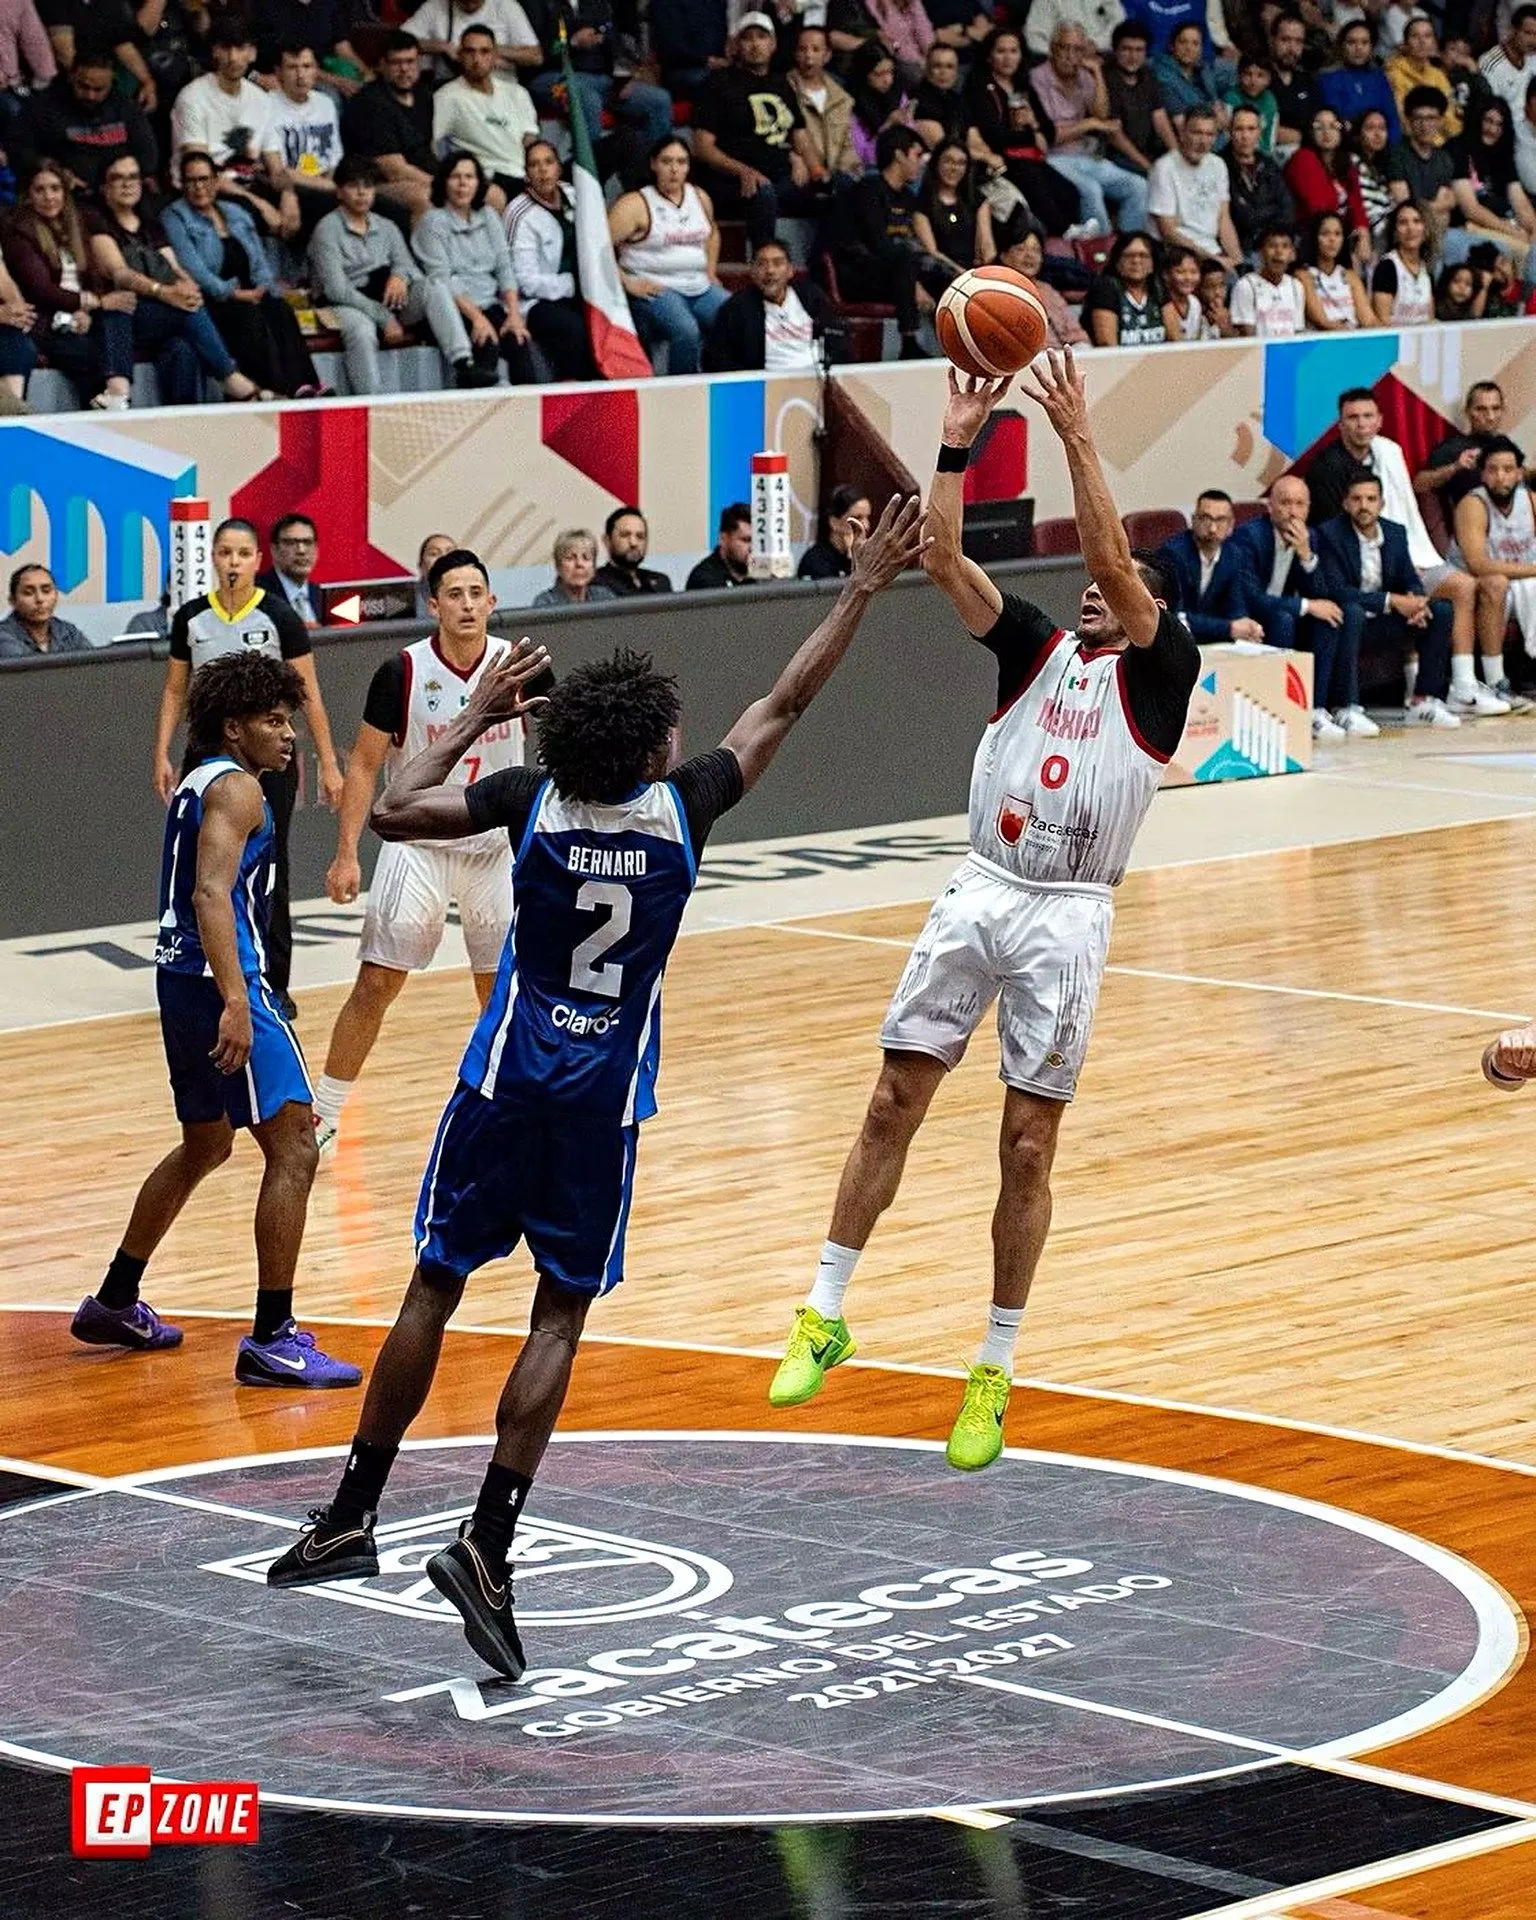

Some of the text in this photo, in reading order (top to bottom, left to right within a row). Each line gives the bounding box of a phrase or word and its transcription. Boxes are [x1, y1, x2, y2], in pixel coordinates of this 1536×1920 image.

[463, 756, 482, 784] 7
[1040, 755, 1069, 789] 0
[567, 845, 647, 877] BERNARD
[569, 880, 633, 998] 2
[551, 1003, 615, 1036] Claro
[381, 1550, 1094, 1721] Zacatecas
[522, 1574, 1173, 1738] GOBIERNO DEL ESTADO
[786, 1632, 1076, 1709] 2021-2027
